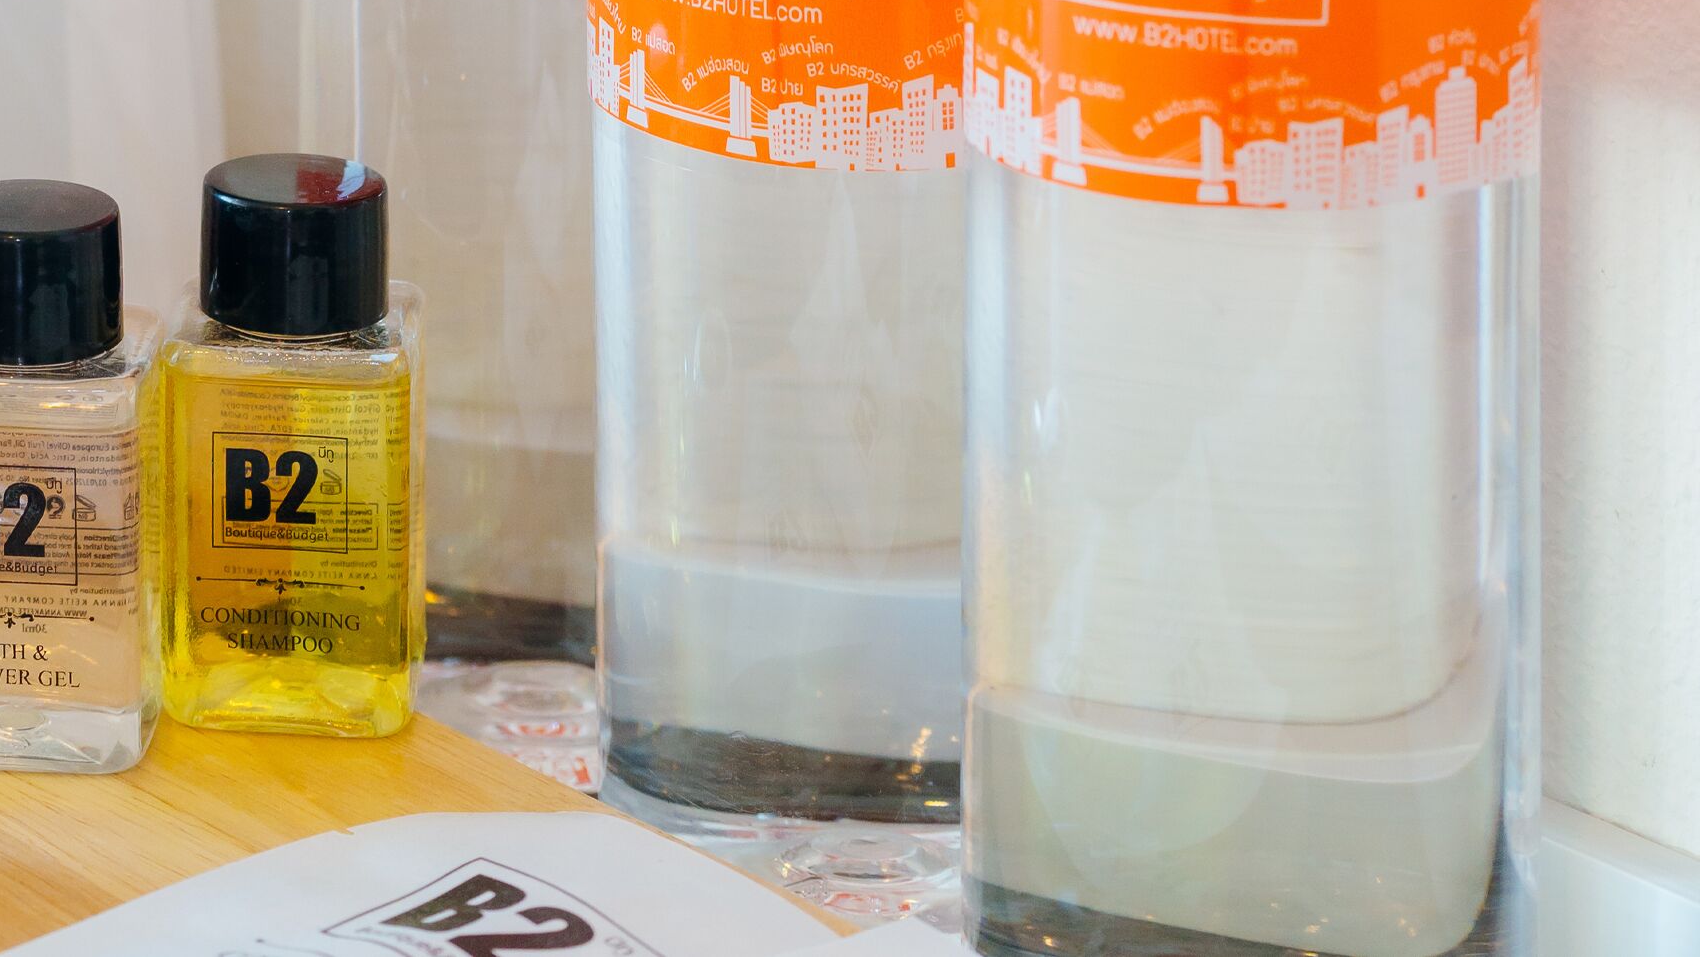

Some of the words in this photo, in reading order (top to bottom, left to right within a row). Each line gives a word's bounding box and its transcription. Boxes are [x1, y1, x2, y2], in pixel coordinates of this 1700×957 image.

[1072, 14, 1300, 56] www.B2HOTEL.com
[761, 49, 776, 65] B2
[903, 49, 924, 70] B2
[806, 62, 825, 78] B2
[681, 71, 698, 92] B2
[761, 77, 777, 94] B2
[225, 448, 318, 524] B2
[225, 527, 329, 543] Boutique&Budget
[200, 606, 360, 631] CONDITIONING
[33, 645, 48, 660] &
[227, 633, 333, 654] SHAMPOO
[38, 670, 80, 688] GEL
[380, 874, 595, 957] B2
